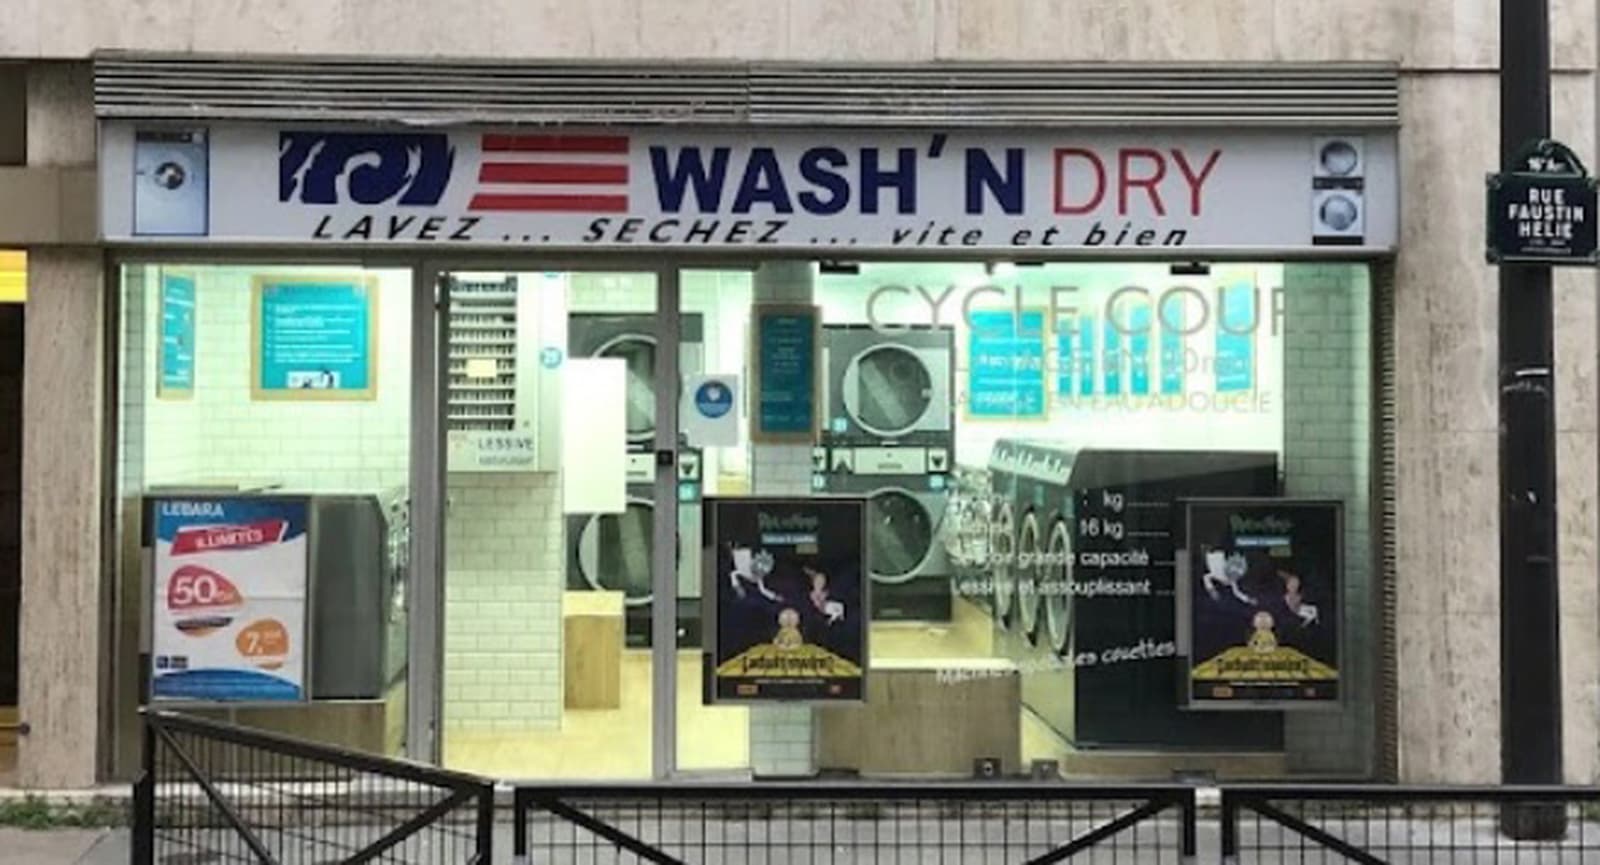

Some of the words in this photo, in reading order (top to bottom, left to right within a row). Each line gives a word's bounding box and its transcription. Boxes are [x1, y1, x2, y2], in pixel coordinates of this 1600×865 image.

[1052, 148, 1222, 216] DRY
[1529, 188, 1565, 204] RUE
[1509, 203, 1584, 223] FAUSTIN
[312, 215, 481, 240] LAVEZ
[583, 217, 788, 244] SECHEZ
[892, 222, 983, 246] vite
[1012, 224, 1060, 247] et
[1085, 221, 1189, 247] bien
[866, 285, 1079, 336] CYCLE
[162, 503, 224, 517] LEBARA
[1103, 491, 1124, 512] kg
[1081, 519, 1099, 537] 16
[1103, 518, 1124, 540] kg
[1081, 547, 1150, 569] capacité
